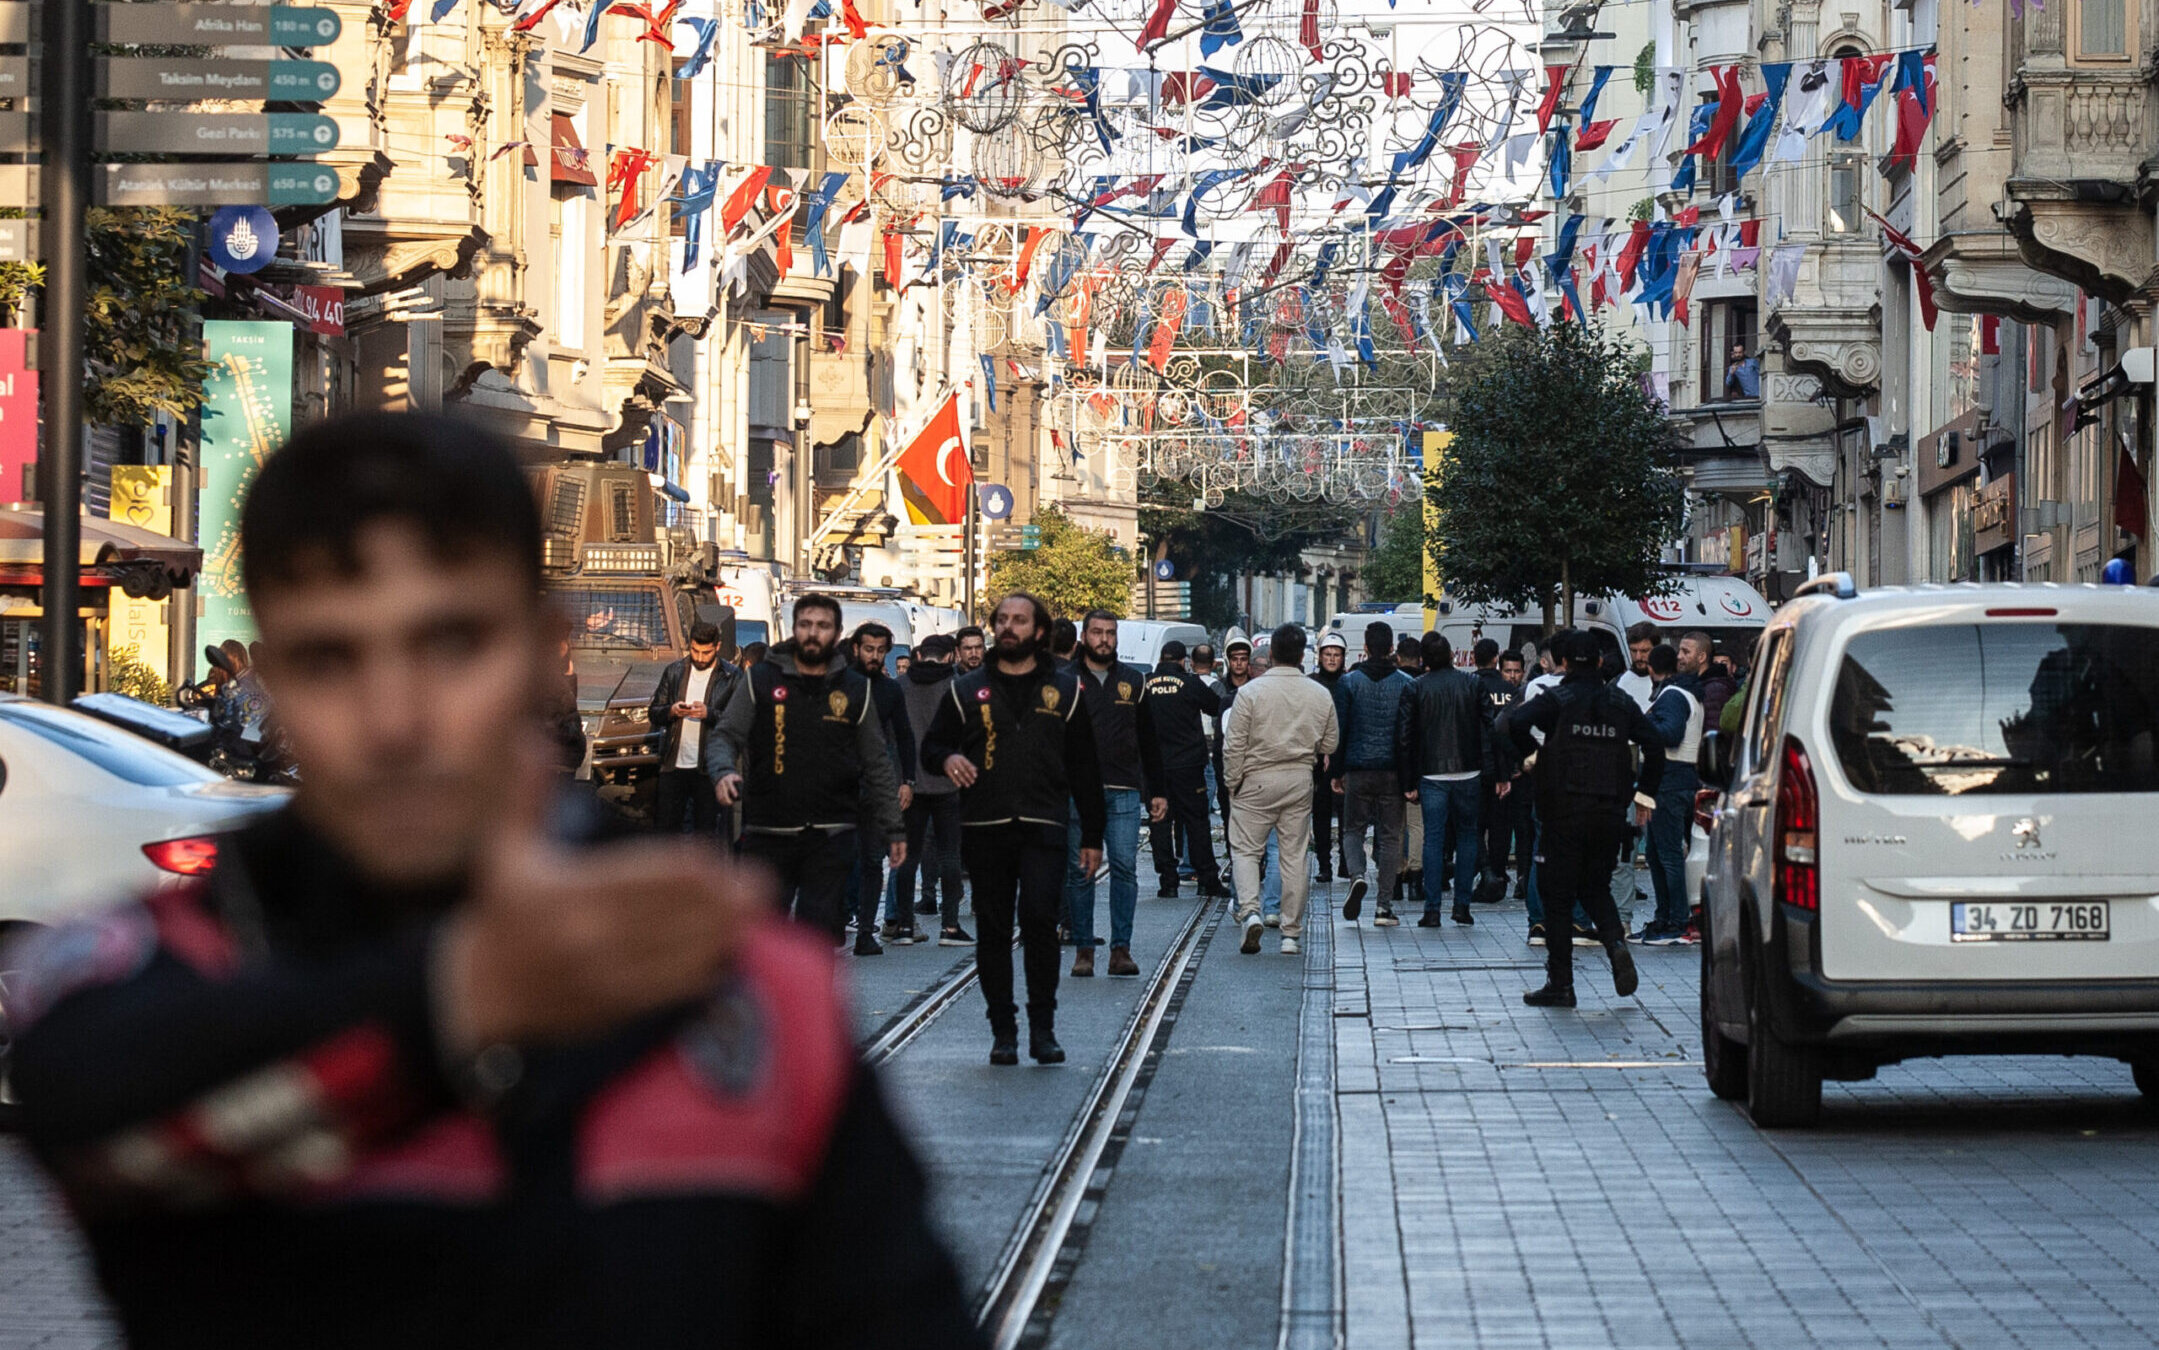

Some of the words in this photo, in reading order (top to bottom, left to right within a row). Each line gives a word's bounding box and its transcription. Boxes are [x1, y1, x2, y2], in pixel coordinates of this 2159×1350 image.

[194, 19, 232, 31] Afrika
[236, 20, 263, 31] Han
[274, 21, 296, 31] 180
[298, 23, 310, 31] m
[159, 72, 203, 86] Taksim
[205, 73, 262, 89] Meydanı
[274, 75, 297, 86] 450
[298, 77, 310, 86] m
[196, 127, 226, 139] Gezi
[273, 128, 295, 138] 575
[297, 130, 309, 138] m
[168, 178, 207, 191] Kültür
[209, 179, 261, 191] Merkezi
[273, 179, 295, 189] 650
[297, 181, 309, 189] m
[324, 301, 343, 326] 40
[723, 595, 744, 607] 12
[1650, 600, 1682, 612] 112
[1490, 692, 1512, 705] LİS
[1572, 722, 1617, 737] POLİS
[1969, 906, 1997, 930] 34
[2010, 906, 2038, 930] ZD
[2051, 906, 2102, 930] 7168
